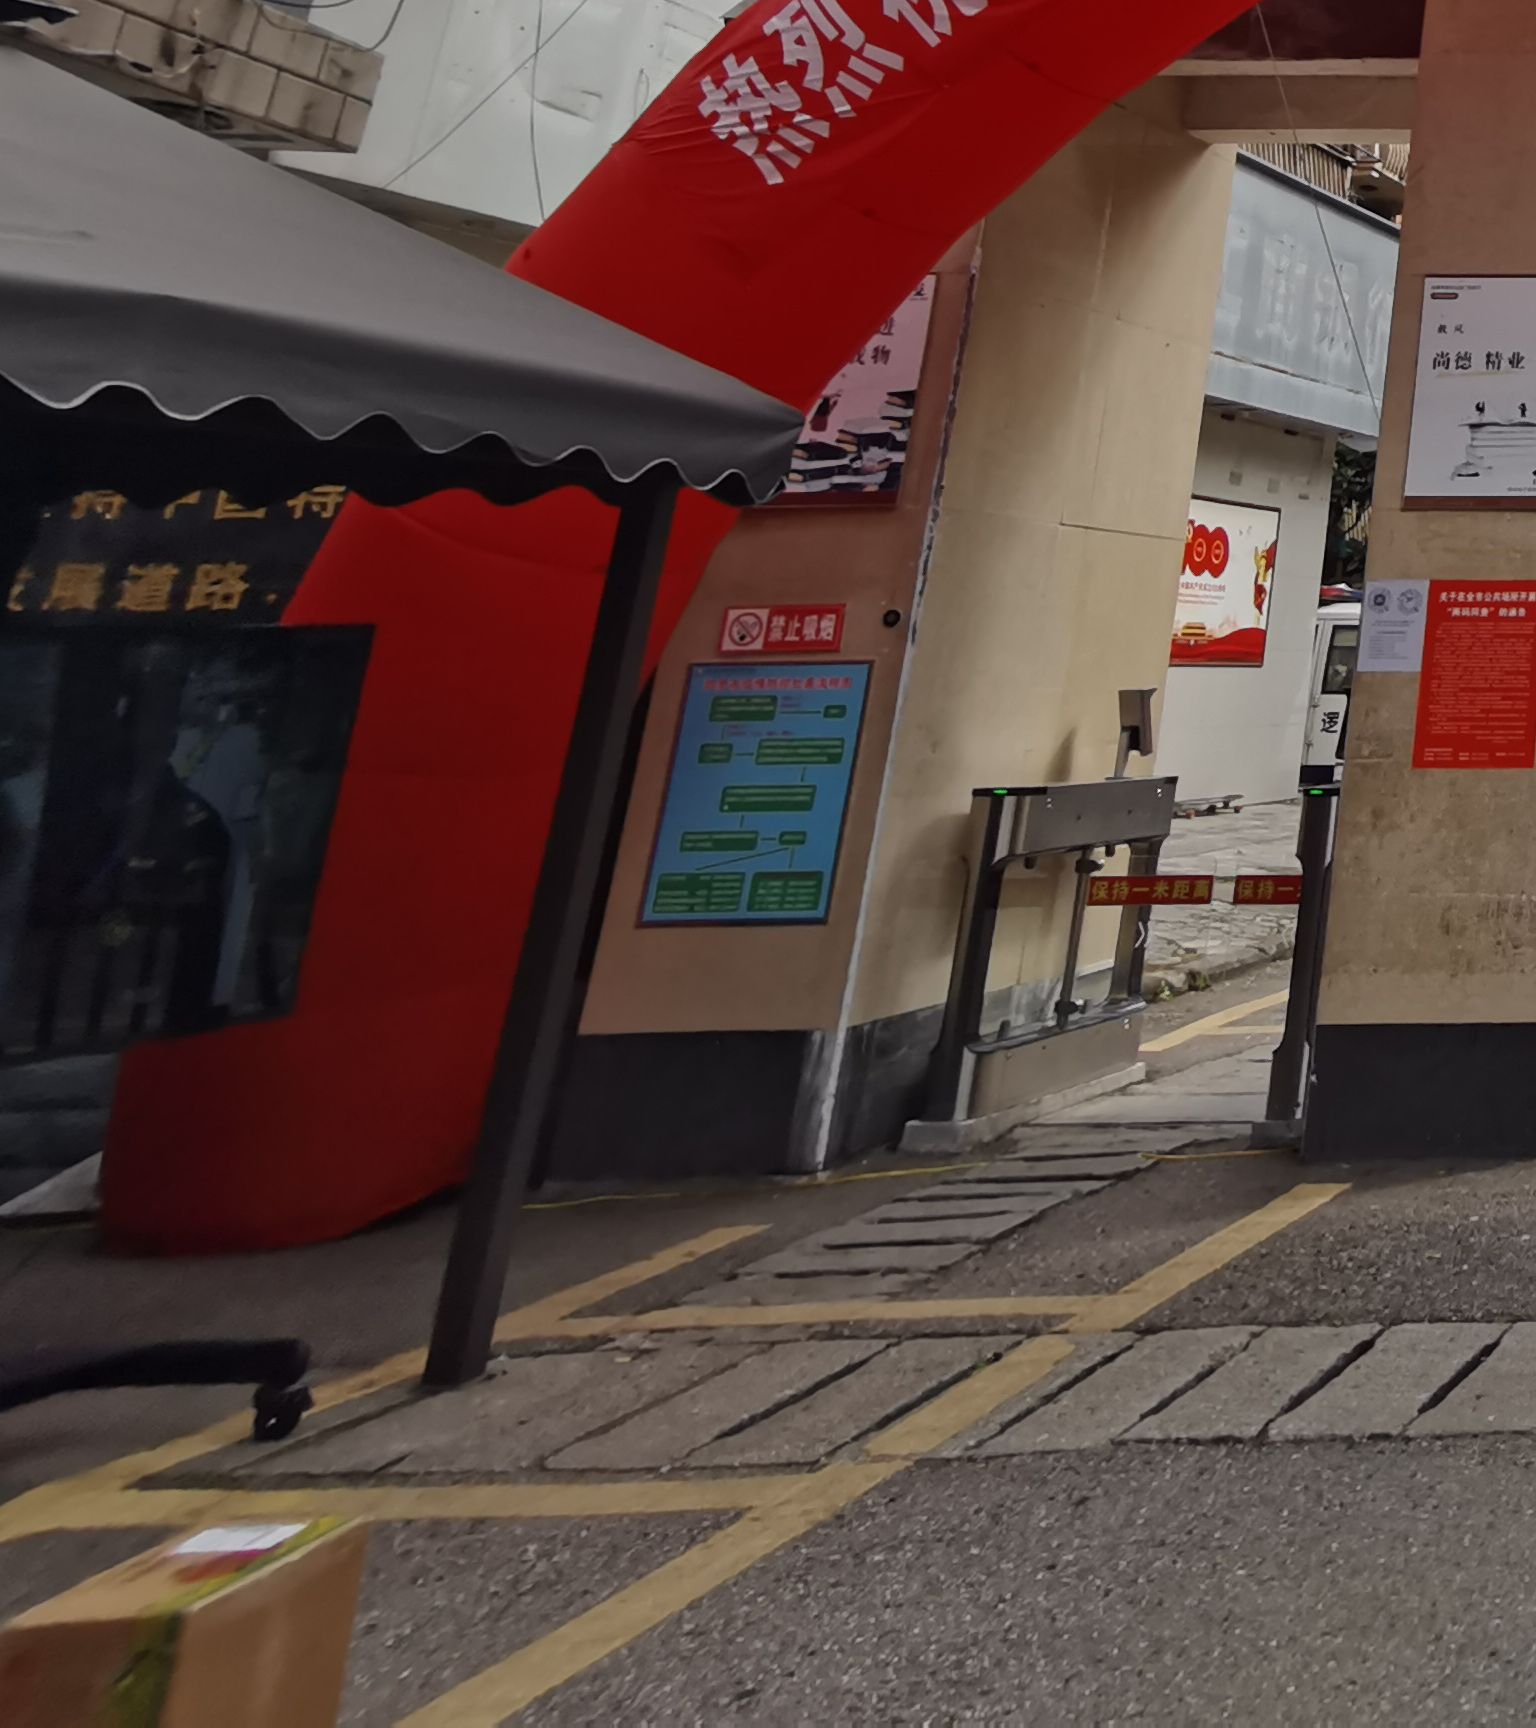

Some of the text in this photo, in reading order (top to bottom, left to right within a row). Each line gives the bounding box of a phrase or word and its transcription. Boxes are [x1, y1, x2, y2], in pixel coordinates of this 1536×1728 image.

[1432, 350, 1472, 371] 尚德
[1485, 350, 1526, 371] 精业
[768, 614, 837, 643] 禁止吸烟
[1320, 711, 1340, 734] 逻
[1091, 879, 1300, 901] 保持一米距离 保持一
